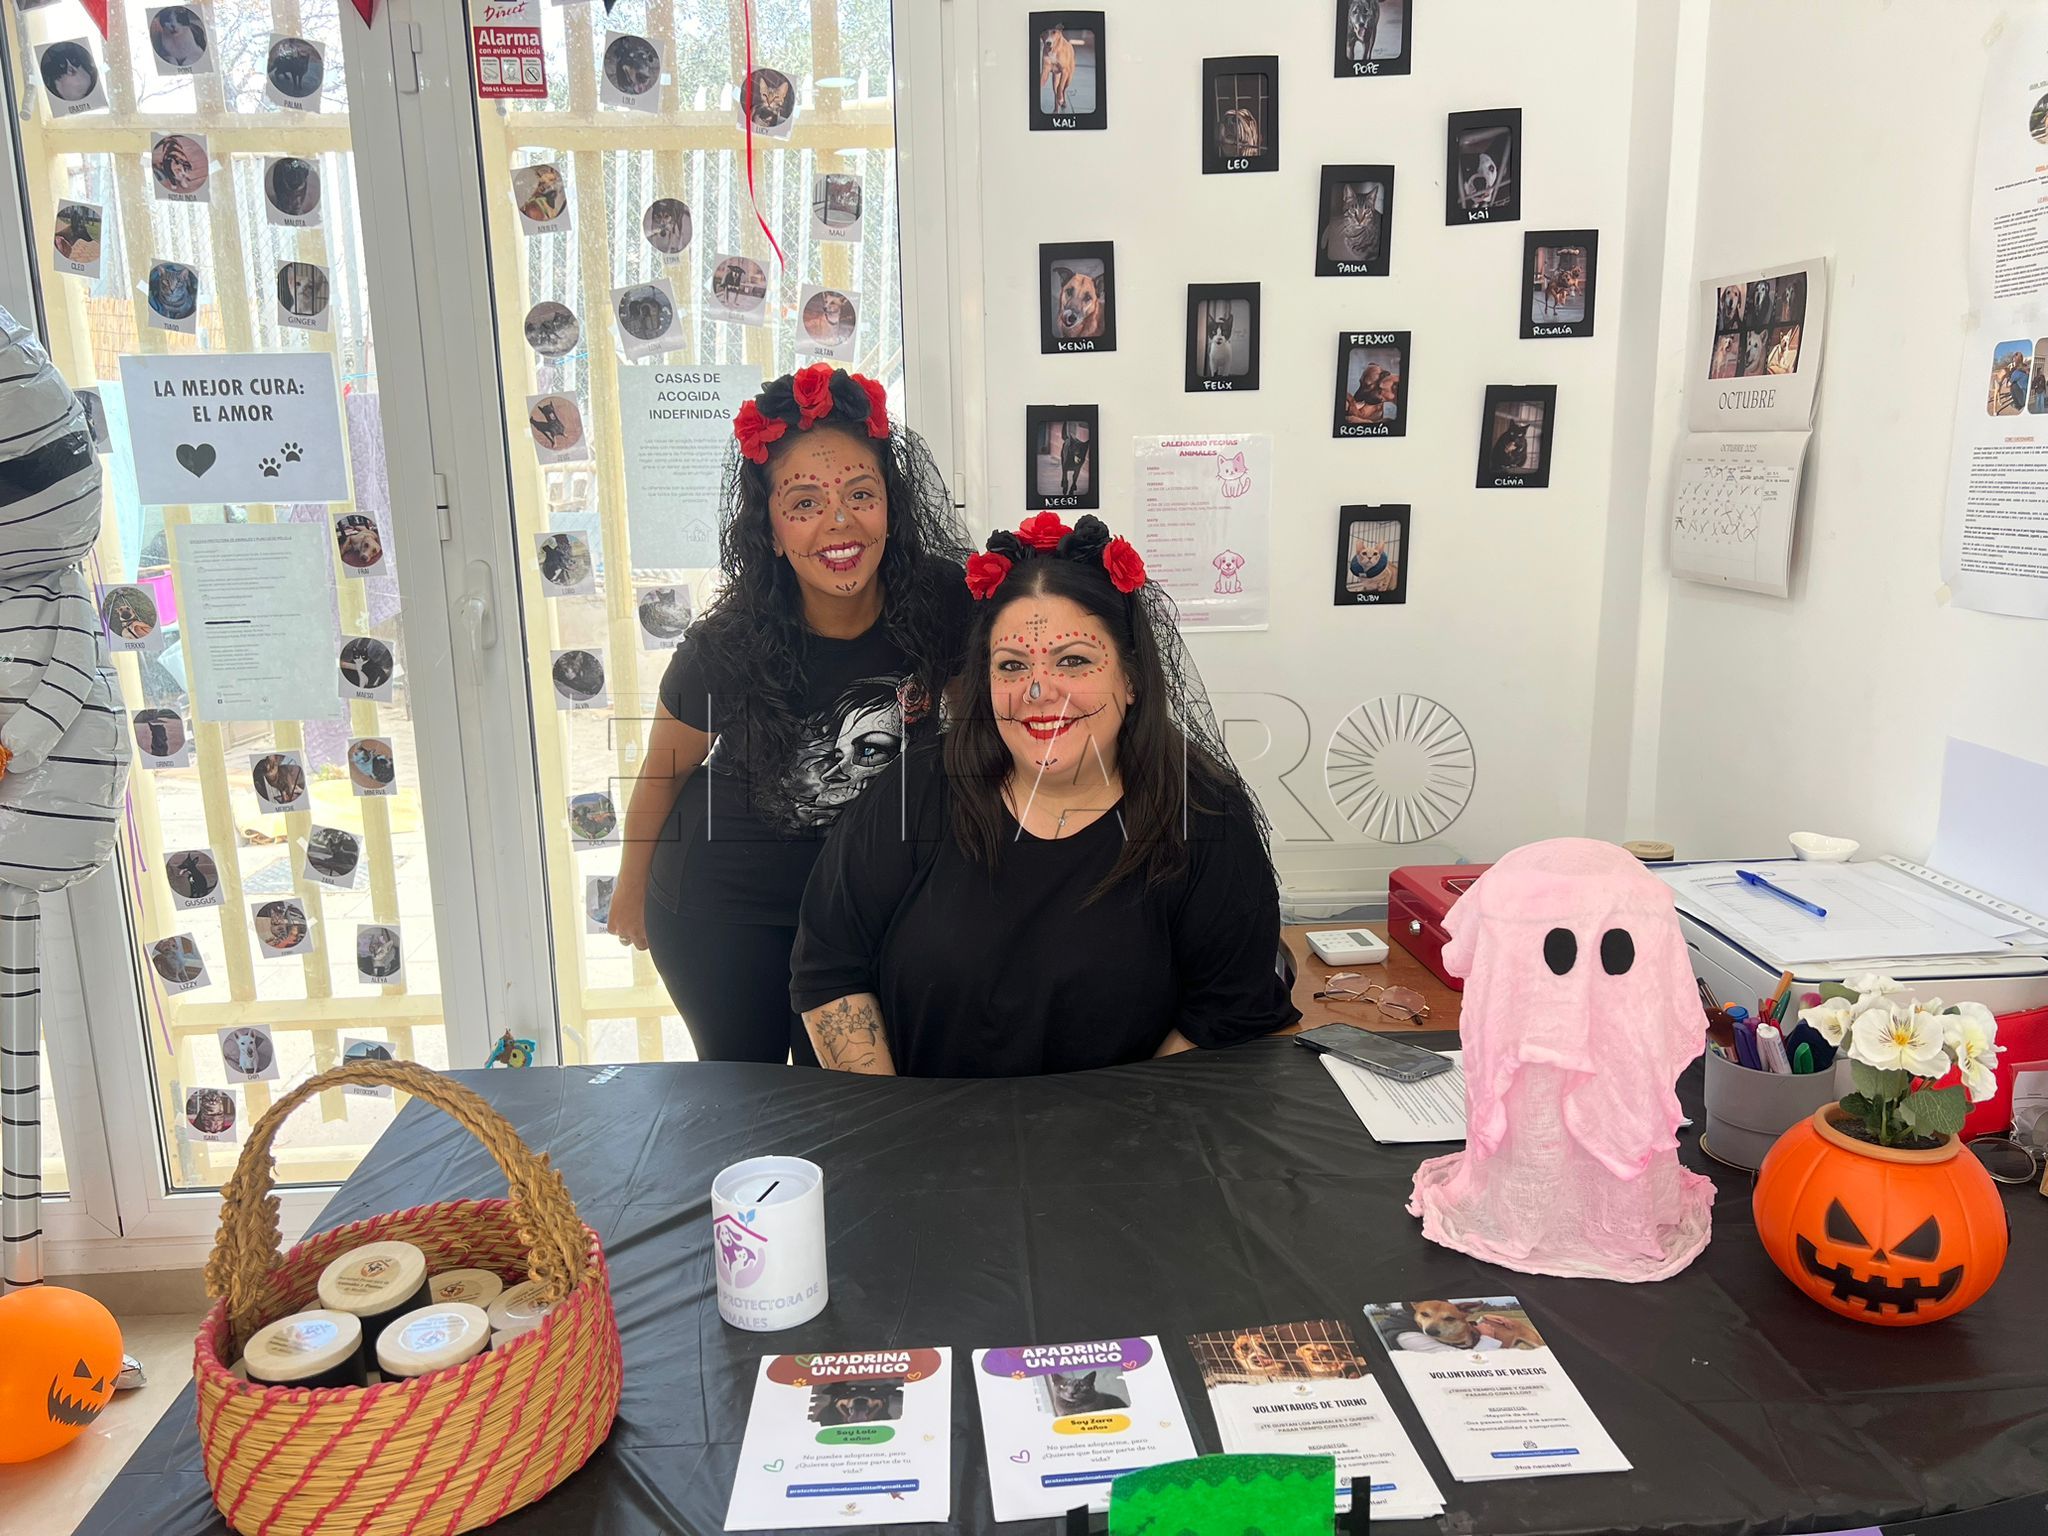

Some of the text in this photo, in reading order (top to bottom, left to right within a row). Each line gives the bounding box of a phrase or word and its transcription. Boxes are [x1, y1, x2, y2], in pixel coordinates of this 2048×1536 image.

[484, 1, 529, 22] Direct
[479, 29, 540, 46] Alarma
[493, 47, 510, 55] aviso
[1352, 62, 1380, 76] POPE
[1227, 159, 1249, 170] LEO
[829, 229, 846, 237] MAU
[70, 262, 85, 271] CLEO
[287, 316, 316, 326] GINGER
[1350, 333, 1395, 345] FERXXO
[655, 373, 721, 384] CASAS DE
[154, 378, 304, 397] LA MEJOR CURA:
[657, 391, 721, 401] ACOGIDA
[1718, 389, 1777, 410] OCTUBRE
[193, 404, 274, 422] EL AMOR
[650, 409, 731, 420] INDEFINIDAS
[1161, 440, 1208, 448] CALENDARIO
[184, 896, 217, 907] GUSGUS
[179, 981, 198, 991] LIZZY
[723, 1282, 819, 1311] PROTECTORA DE
[1022, 1341, 1122, 1359] APADRINA
[810, 1351, 911, 1367] APADRINA
[1025, 1352, 1122, 1368] UN AMIGO
[811, 1363, 910, 1376] UN AMIGO
[1428, 1367, 1547, 1380] VOLUNTARIOS DE PASEOS
[1252, 1397, 1367, 1414] VOLUNTARIOS DE TURNO
[836, 1429, 855, 1437] Soy
